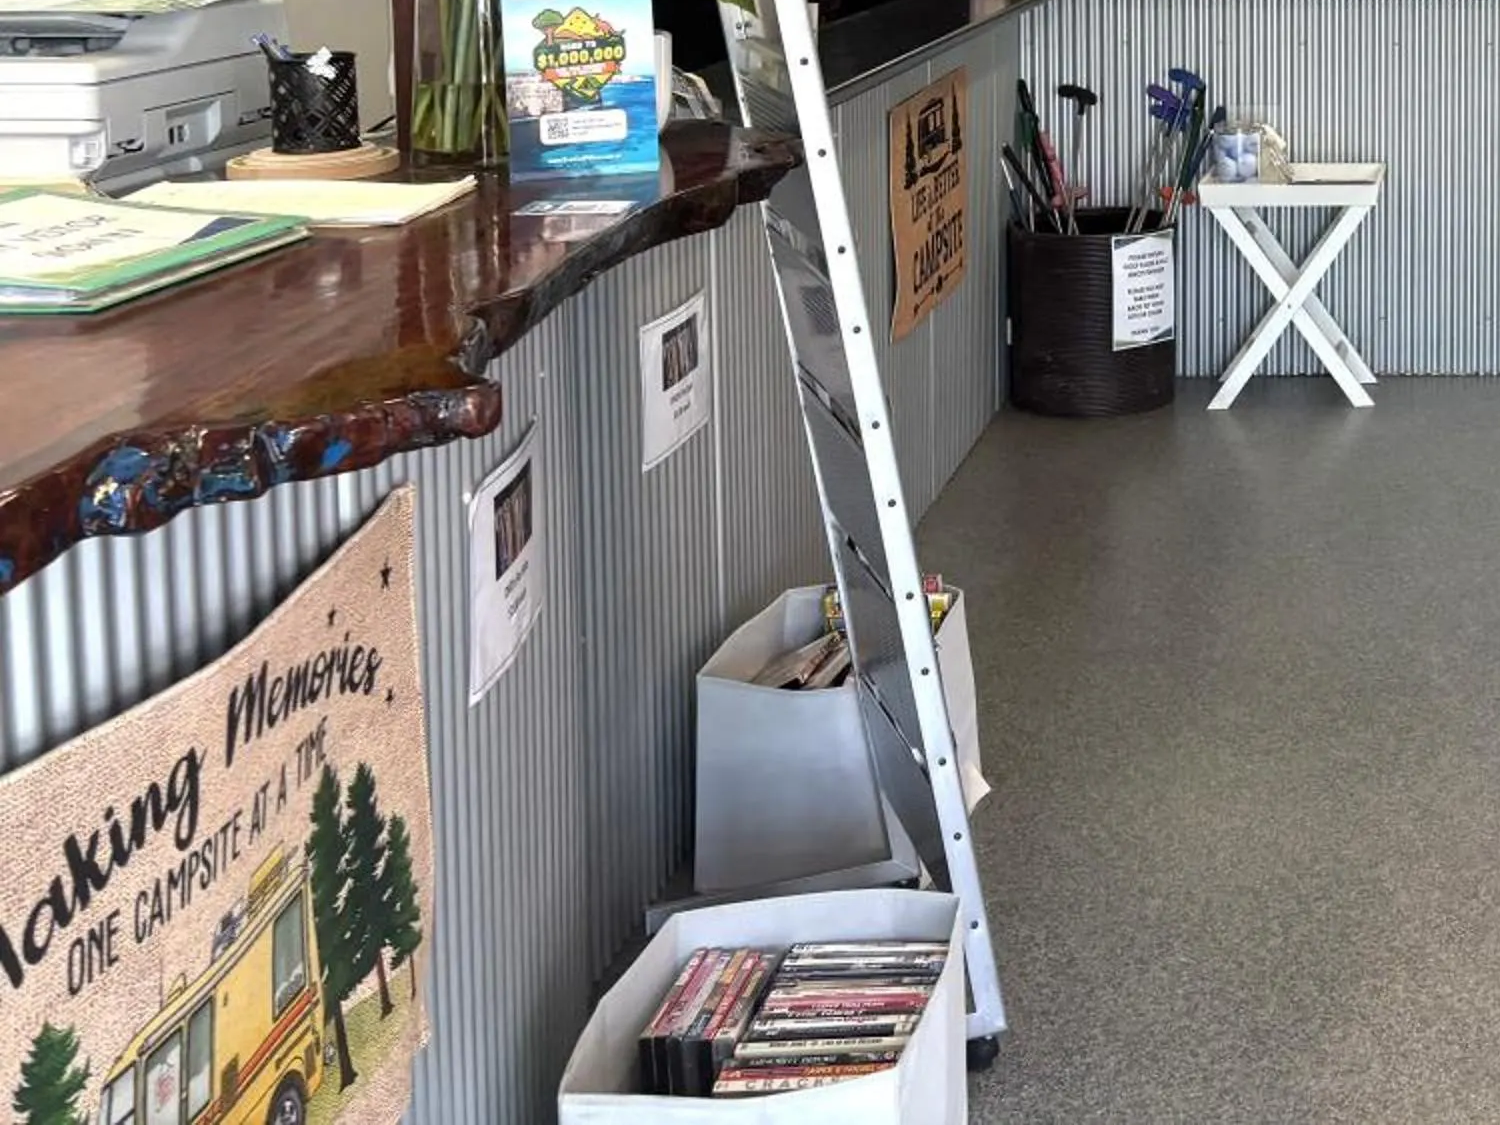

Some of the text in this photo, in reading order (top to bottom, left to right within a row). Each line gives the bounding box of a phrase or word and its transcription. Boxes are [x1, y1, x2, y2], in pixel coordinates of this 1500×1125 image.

[536, 44, 625, 70] $1,000,000
[914, 208, 963, 294] CAMPSITE
[0, 632, 383, 989] aking Memories
[67, 715, 329, 996] ONE CAMPSITE AT A TIME
